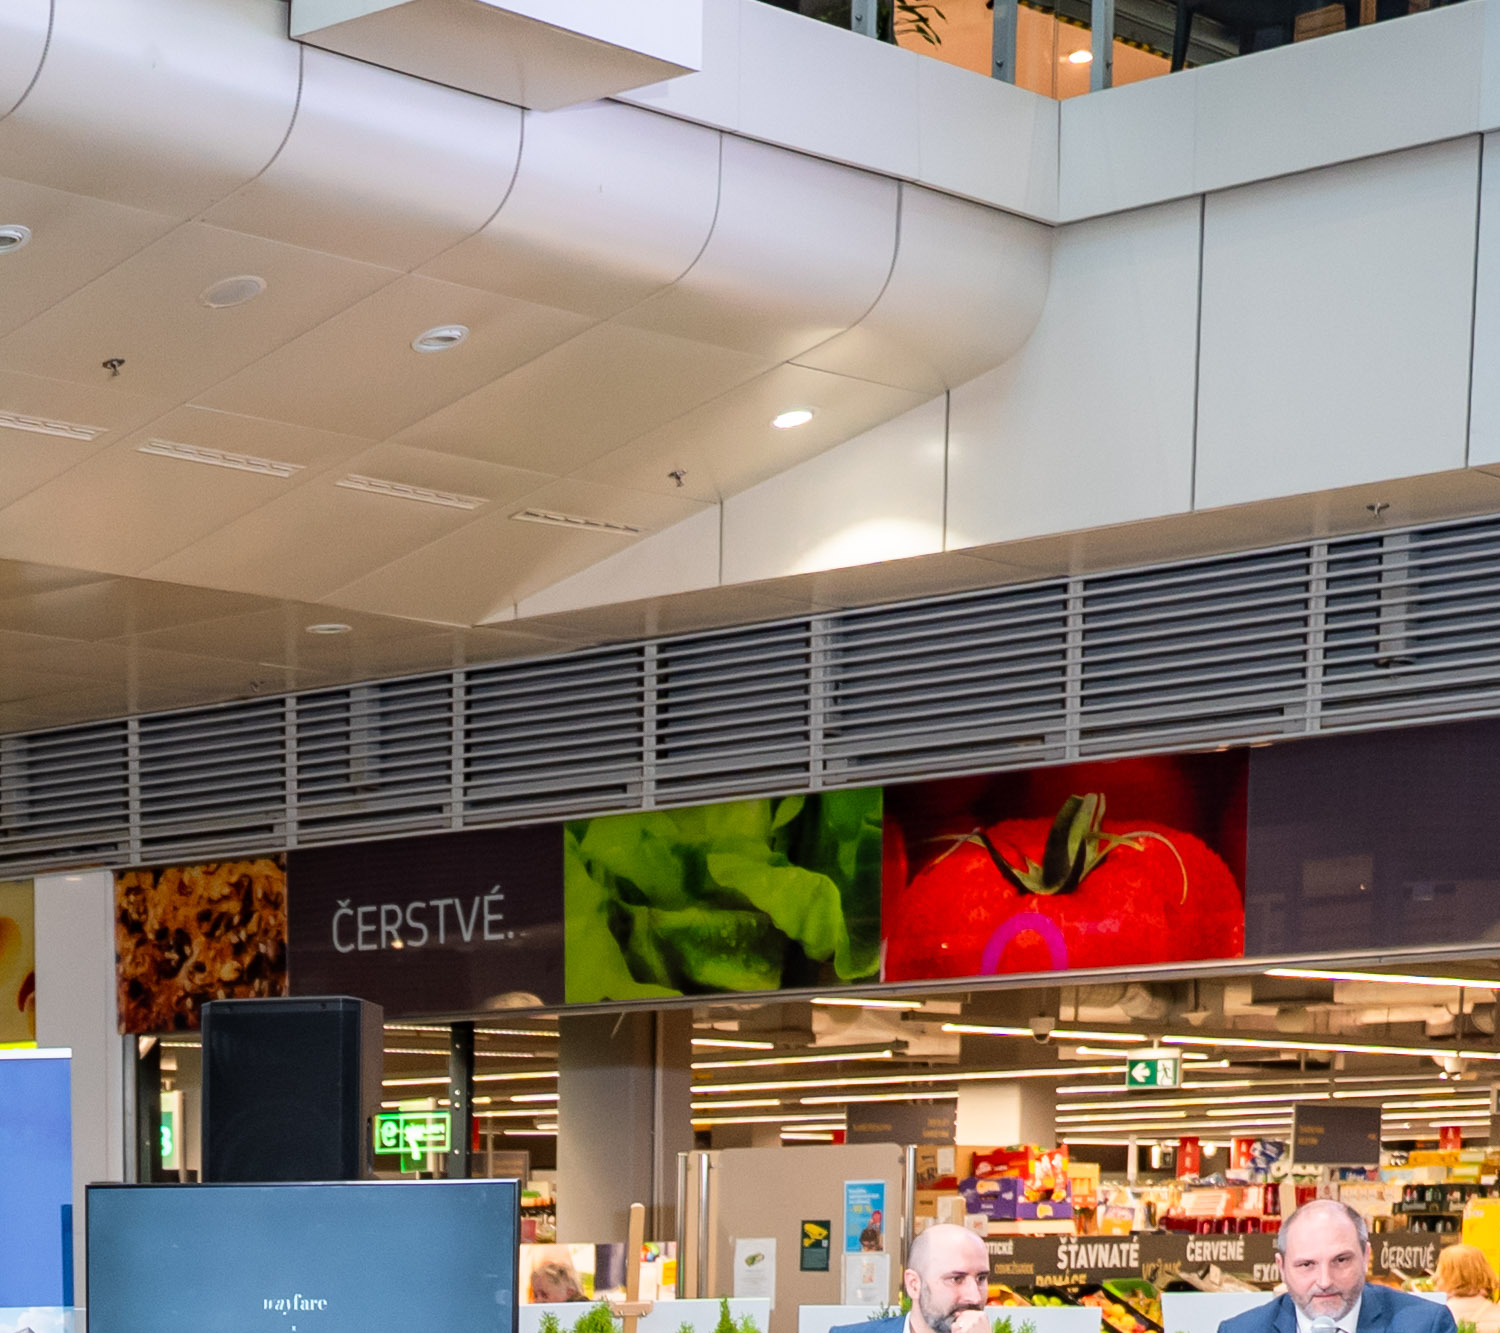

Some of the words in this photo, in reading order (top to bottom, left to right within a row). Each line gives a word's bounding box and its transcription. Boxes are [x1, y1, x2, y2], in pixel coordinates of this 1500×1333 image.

[332, 884, 515, 954] ČERSTVÉ.
[1056, 1236, 1140, 1271] ŠŤAVNATÉ
[1185, 1236, 1245, 1262] ČERVENÉ
[1380, 1240, 1435, 1269] ČERSTVÉ
[263, 1293, 328, 1316] wayfare
